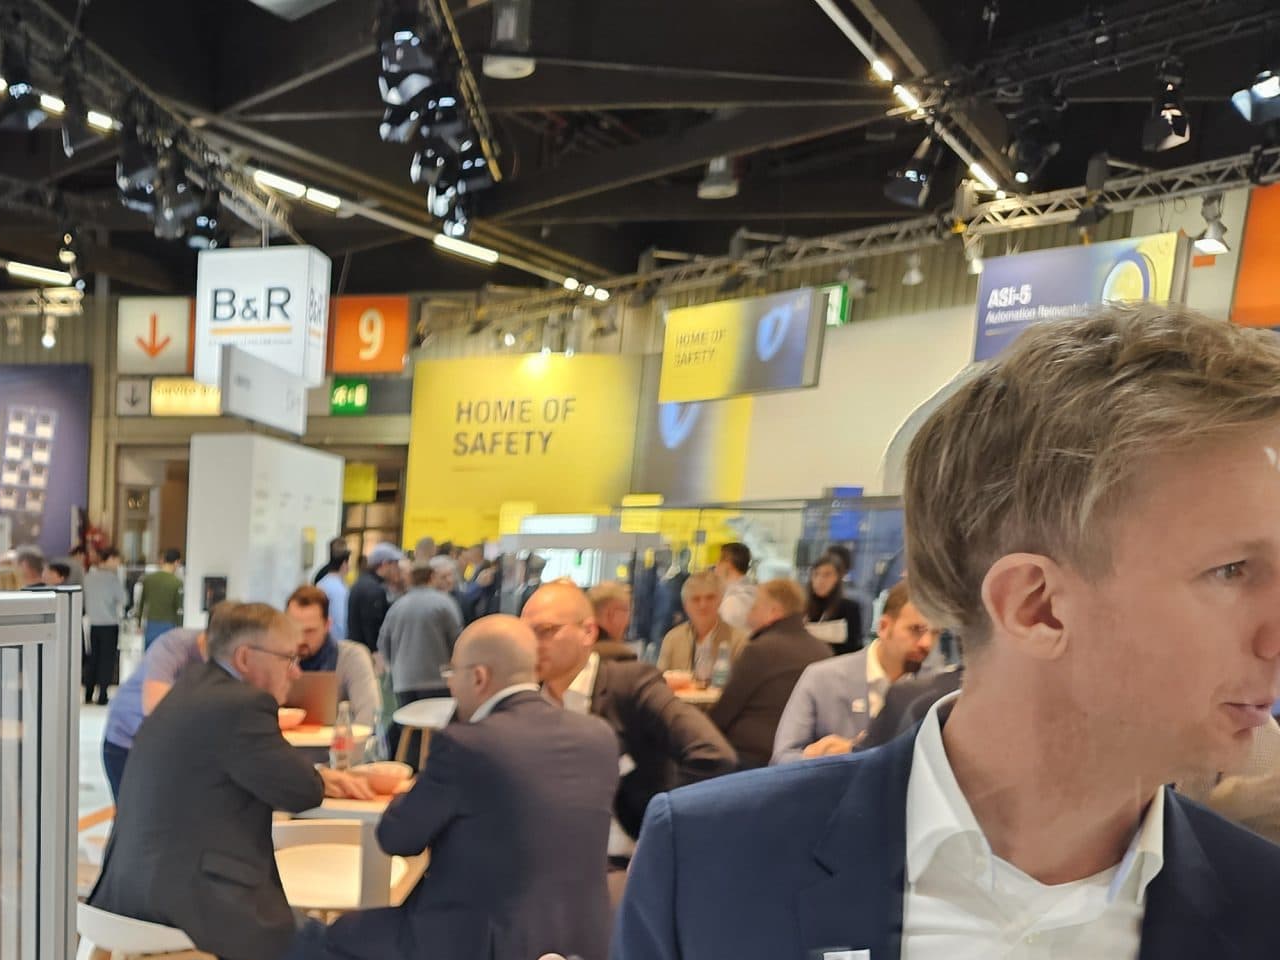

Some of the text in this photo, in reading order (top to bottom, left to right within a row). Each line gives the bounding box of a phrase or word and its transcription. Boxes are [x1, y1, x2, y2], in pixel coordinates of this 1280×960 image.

[212, 286, 291, 321] B&R
[358, 308, 385, 360] 9
[456, 397, 577, 424] HOME OF
[453, 431, 553, 456] SAFETY
